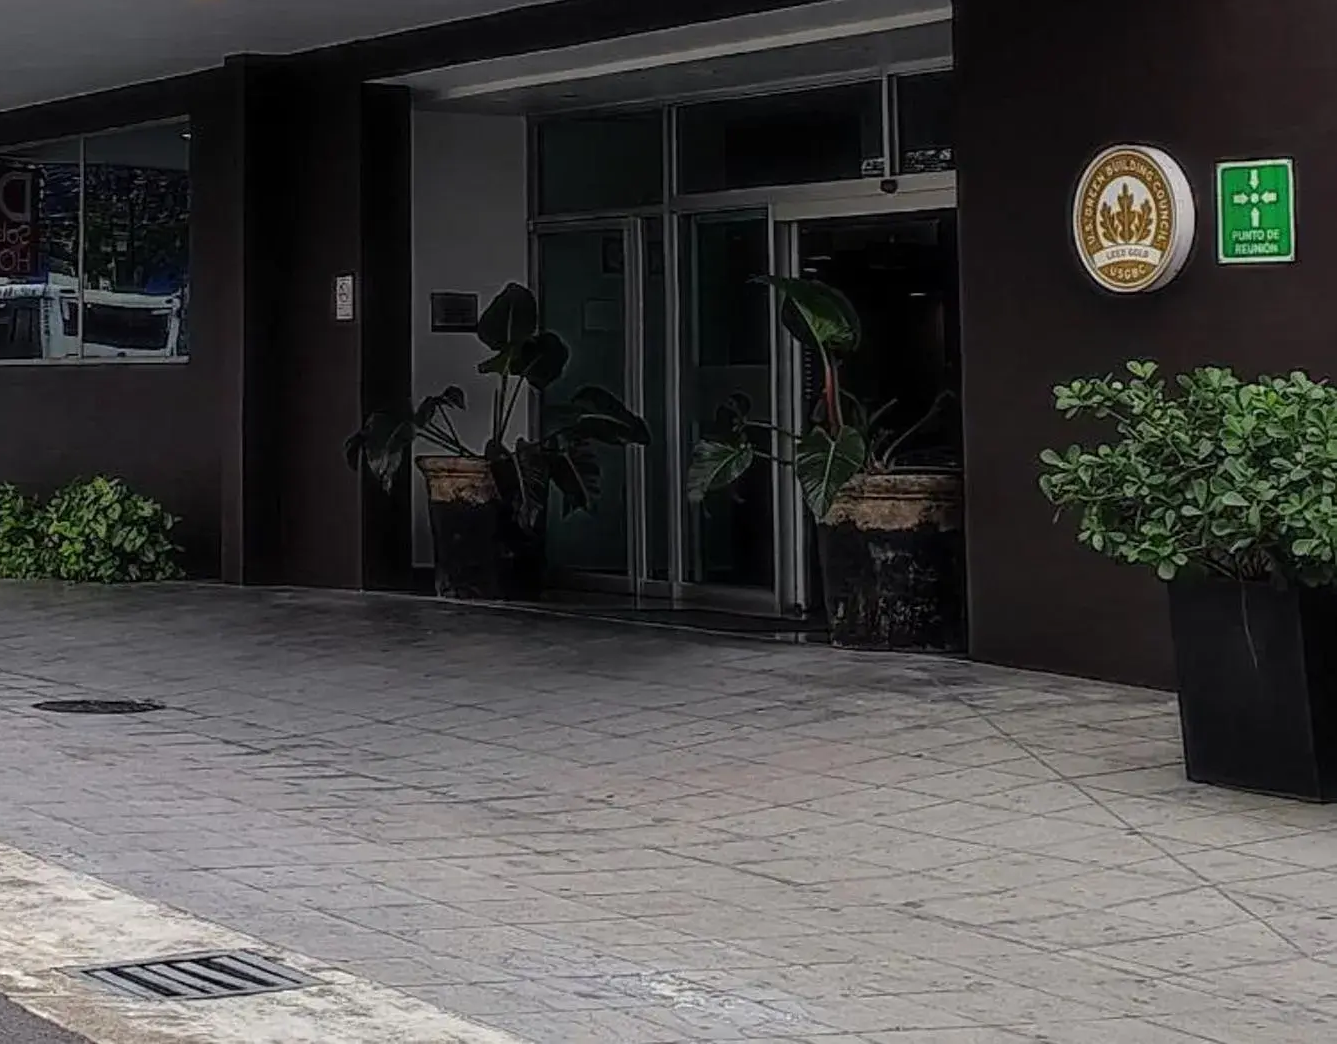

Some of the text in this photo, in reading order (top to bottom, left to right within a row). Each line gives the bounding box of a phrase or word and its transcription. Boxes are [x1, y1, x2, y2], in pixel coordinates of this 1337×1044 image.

[1083, 175, 1106, 217] GREEN
[1106, 159, 1155, 181] BUILDING
[1152, 181, 1170, 242] COUNCIL
[1231, 228, 1280, 242] PUNTO DE
